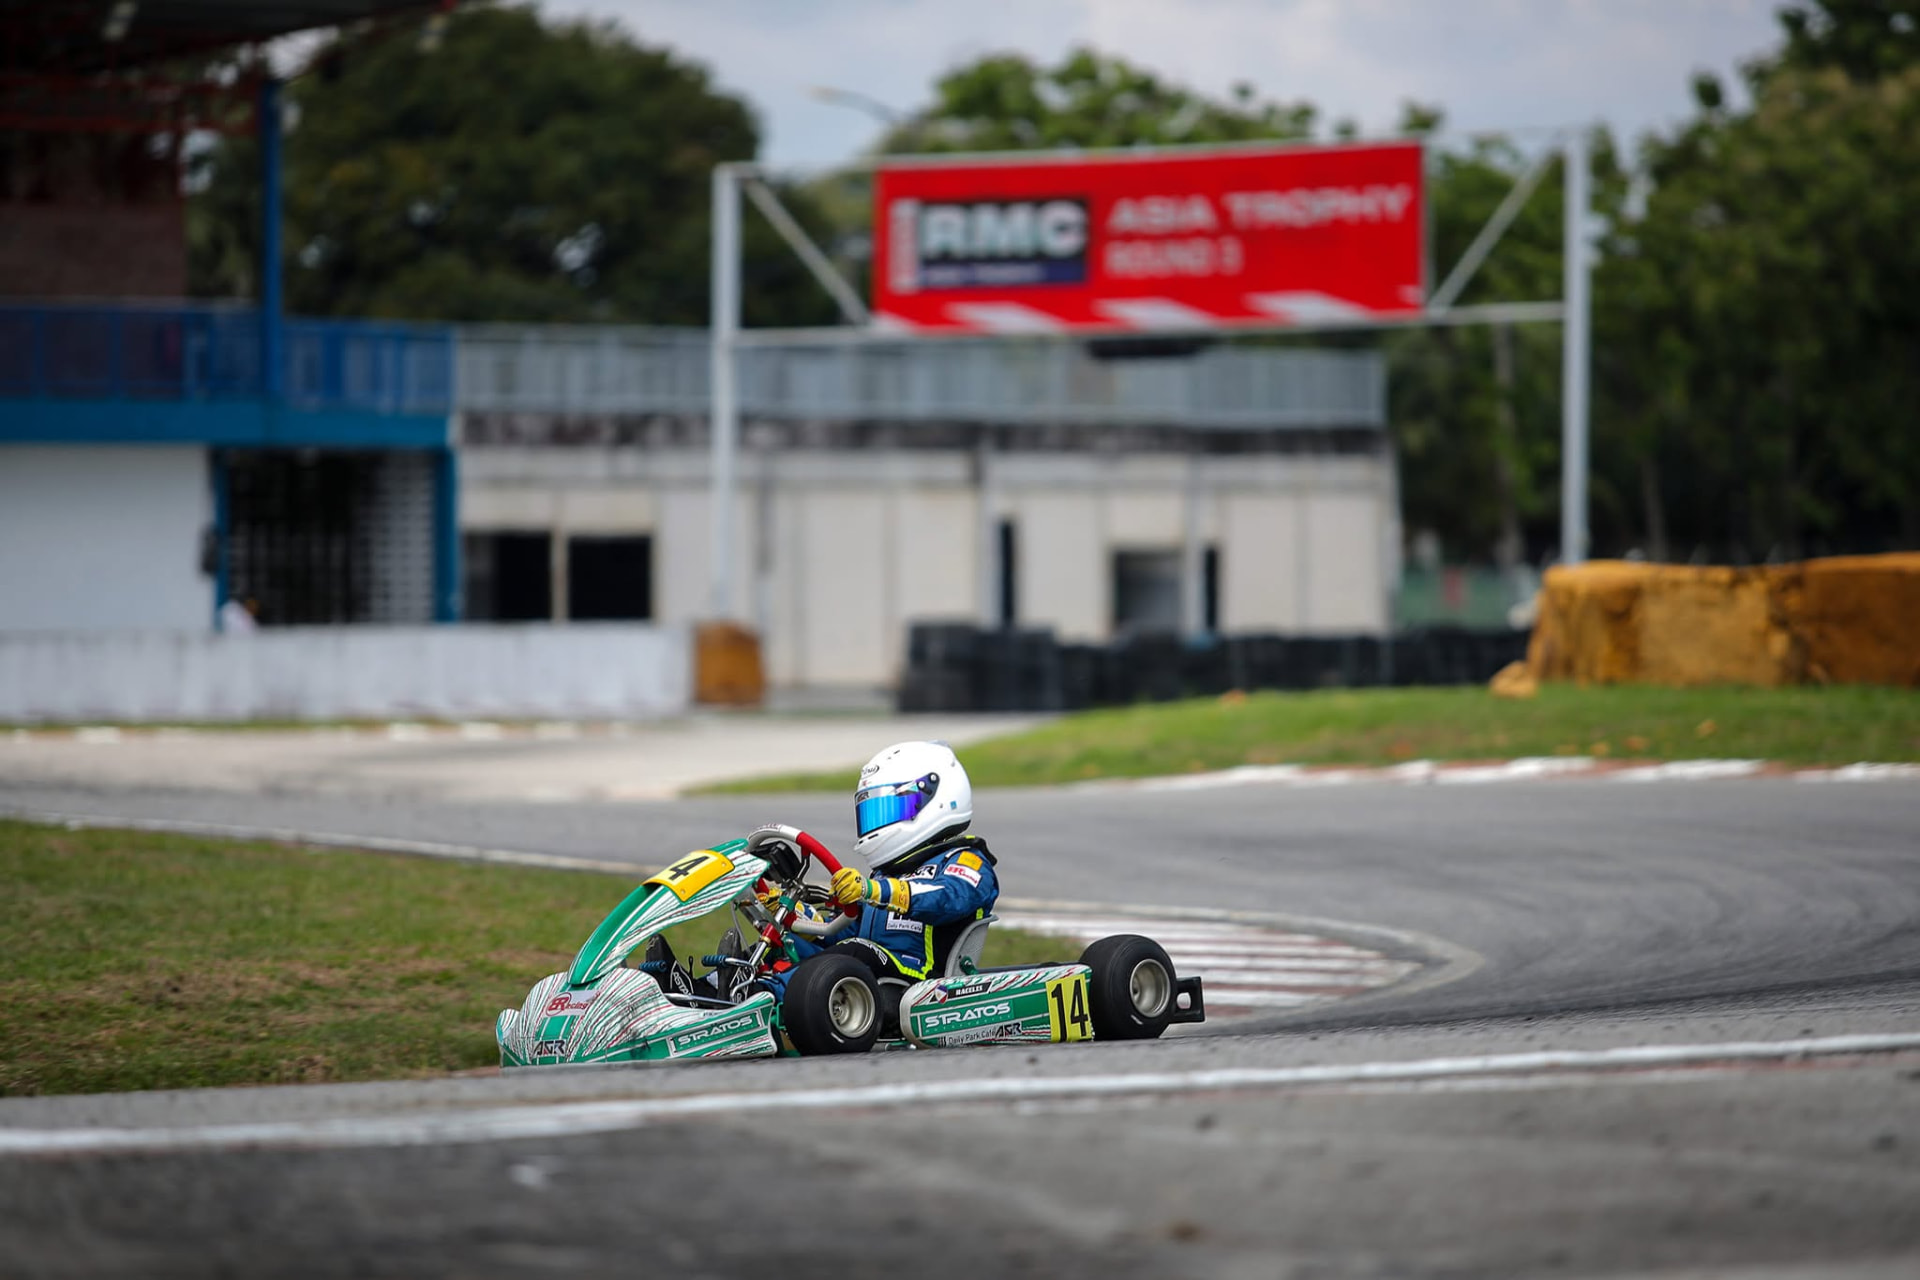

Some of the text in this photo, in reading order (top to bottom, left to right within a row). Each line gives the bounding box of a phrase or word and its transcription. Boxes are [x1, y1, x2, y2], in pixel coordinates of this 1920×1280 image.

[924, 201, 1087, 258] RMC
[1108, 184, 1410, 235] ASIA TROPHY
[1105, 237, 1214, 279] ROUND
[678, 1015, 753, 1045] STRATOS
[925, 1002, 1010, 1028] STRATOS
[1051, 978, 1089, 1043] 14
[948, 1035, 964, 1044] Daily
[966, 1032, 980, 1041] Park
